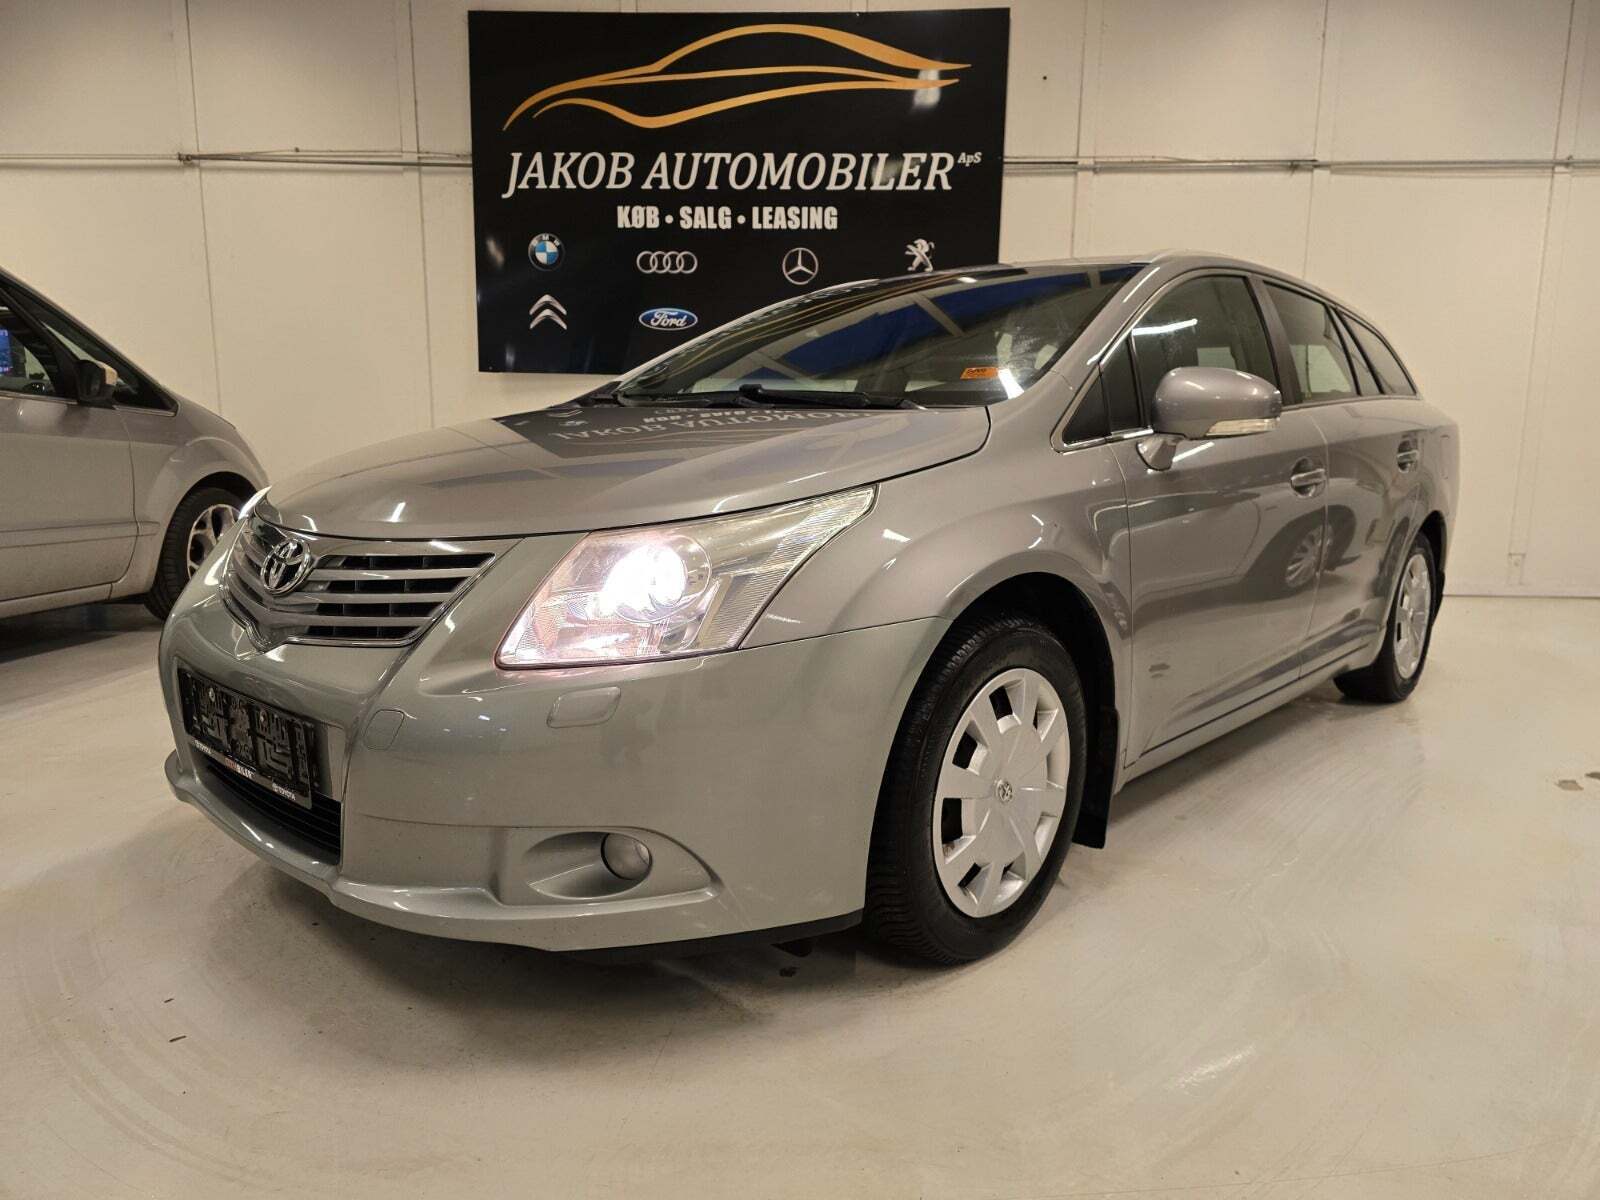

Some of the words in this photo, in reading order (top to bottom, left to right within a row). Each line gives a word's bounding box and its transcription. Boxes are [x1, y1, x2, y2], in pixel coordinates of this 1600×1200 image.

[501, 151, 635, 199] JAKOB
[641, 151, 955, 191] AUTOMOBILER
[957, 151, 982, 166] ApS
[616, 205, 660, 230] KØB
[679, 205, 732, 230] SALG
[752, 205, 838, 230] LEASING
[650, 311, 688, 327] Ford
